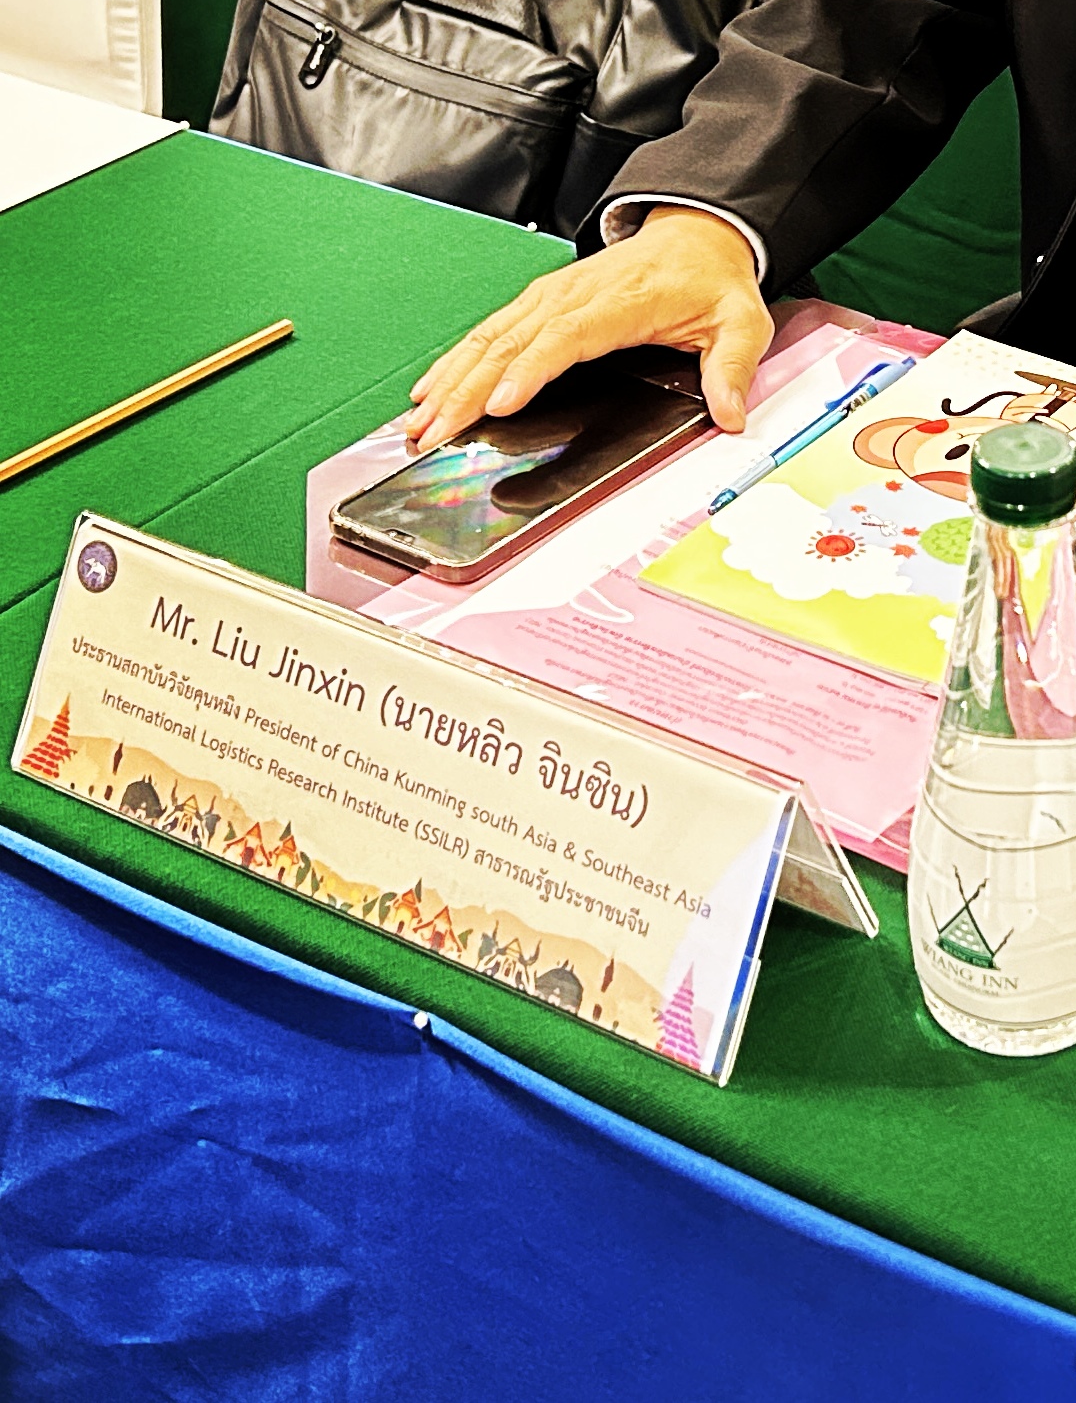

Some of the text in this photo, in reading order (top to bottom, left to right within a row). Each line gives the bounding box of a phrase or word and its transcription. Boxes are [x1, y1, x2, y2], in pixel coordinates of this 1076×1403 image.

[72, 635, 712, 919] ประธานสถาบันวิจัยคุนหมิง President of China Kunming south Asia & Southeast Asia
[101, 689, 650, 938] International Logistics Research Institute (SSILR) สาธารณรัฐประชาชนจีน
[150, 595, 199, 646] Mr.
[211, 620, 262, 670] Liu
[268, 647, 366, 713] Jinxin
[380, 685, 524, 775] (นายหลิว
[538, 740, 649, 828] จินซิน)
[981, 973, 1019, 991] INN
